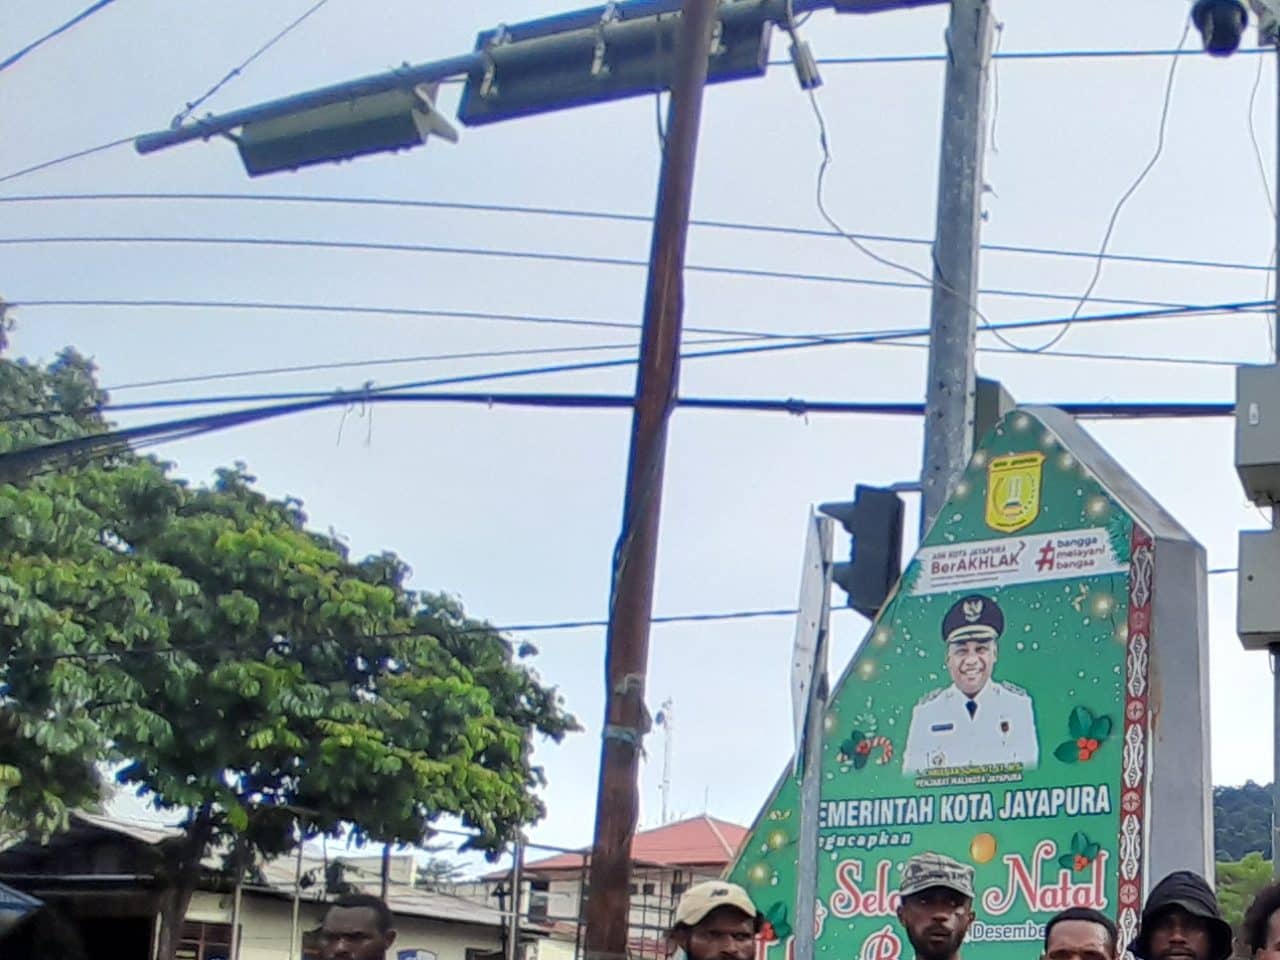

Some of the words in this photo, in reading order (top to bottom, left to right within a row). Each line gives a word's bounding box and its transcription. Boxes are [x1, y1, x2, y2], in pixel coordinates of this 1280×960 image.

[1057, 536, 1098, 549] bangga
[930, 551, 1020, 575] BerAKHLAK
[818, 795, 934, 828] EMERINTAH
[940, 792, 993, 823] KOTA
[999, 785, 1111, 820] JAYAPURA
[830, 858, 902, 918] Sela
[982, 839, 1110, 916] Natal
[970, 919, 1048, 941] Desembe
